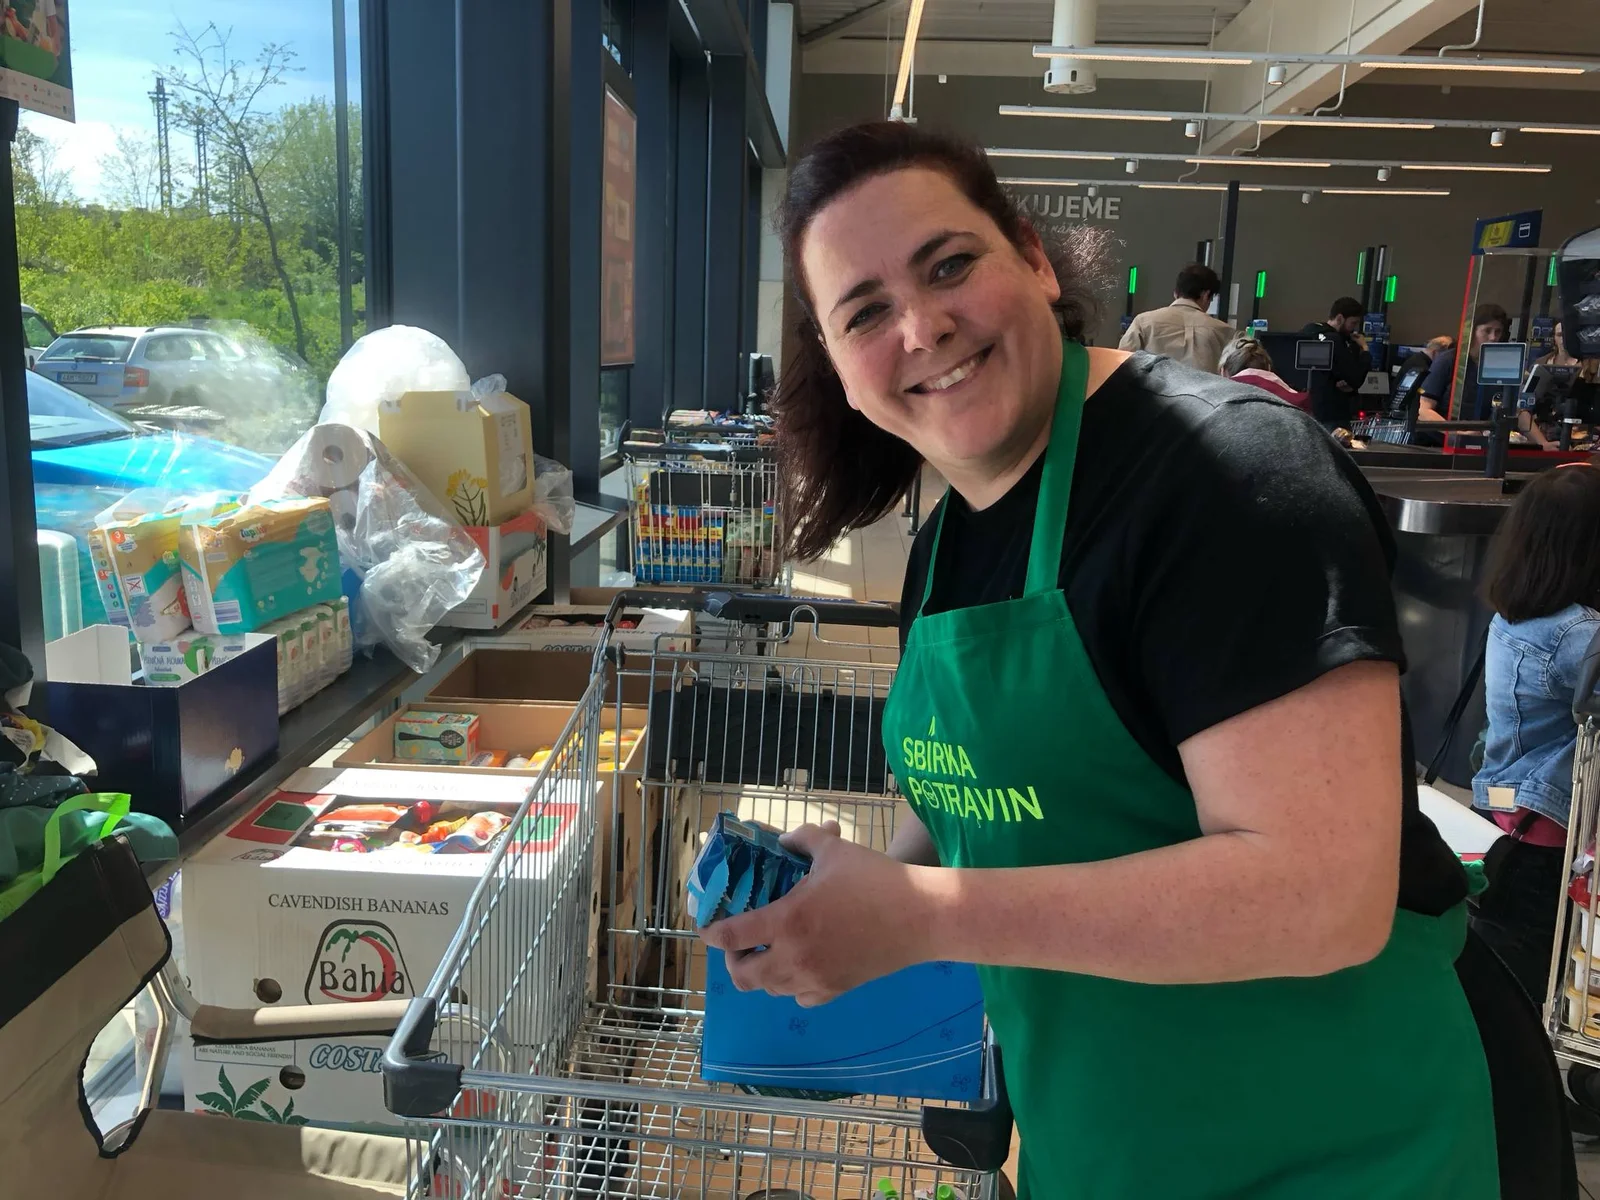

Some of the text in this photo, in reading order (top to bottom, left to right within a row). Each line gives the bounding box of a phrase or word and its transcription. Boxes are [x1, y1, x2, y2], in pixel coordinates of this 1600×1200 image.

[1015, 194, 1121, 220] KUJEME
[903, 715, 977, 779] SBÍRKA
[908, 776, 1044, 822] POTRAVIN
[268, 893, 449, 915] CAVENDISH BANANAS
[320, 960, 405, 994] Bahia
